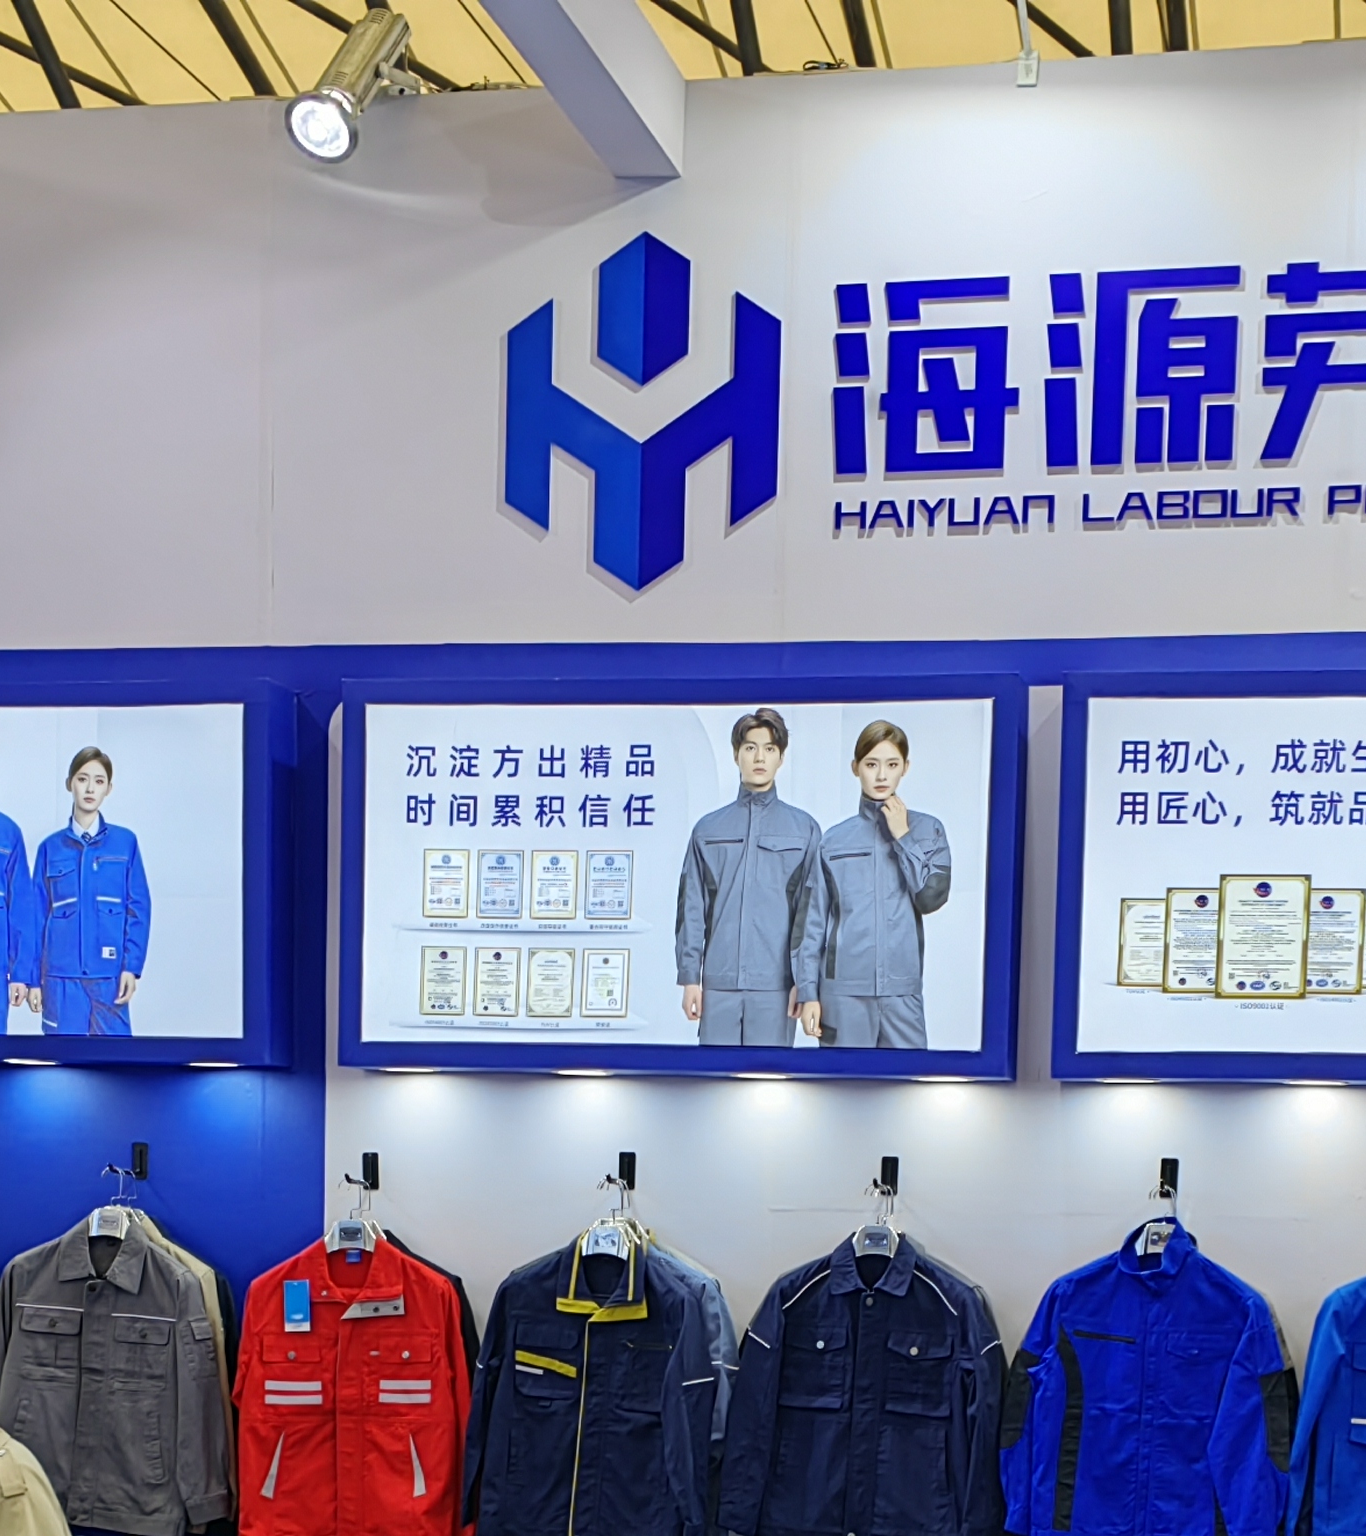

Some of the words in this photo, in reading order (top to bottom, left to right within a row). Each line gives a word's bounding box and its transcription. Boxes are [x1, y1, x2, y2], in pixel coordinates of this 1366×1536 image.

[833, 495, 1055, 530] HAIYUAN
[1082, 487, 1301, 523] LABOUR
[406, 744, 656, 779] 沉淀方出精品
[406, 793, 656, 828] 时间累积信任
